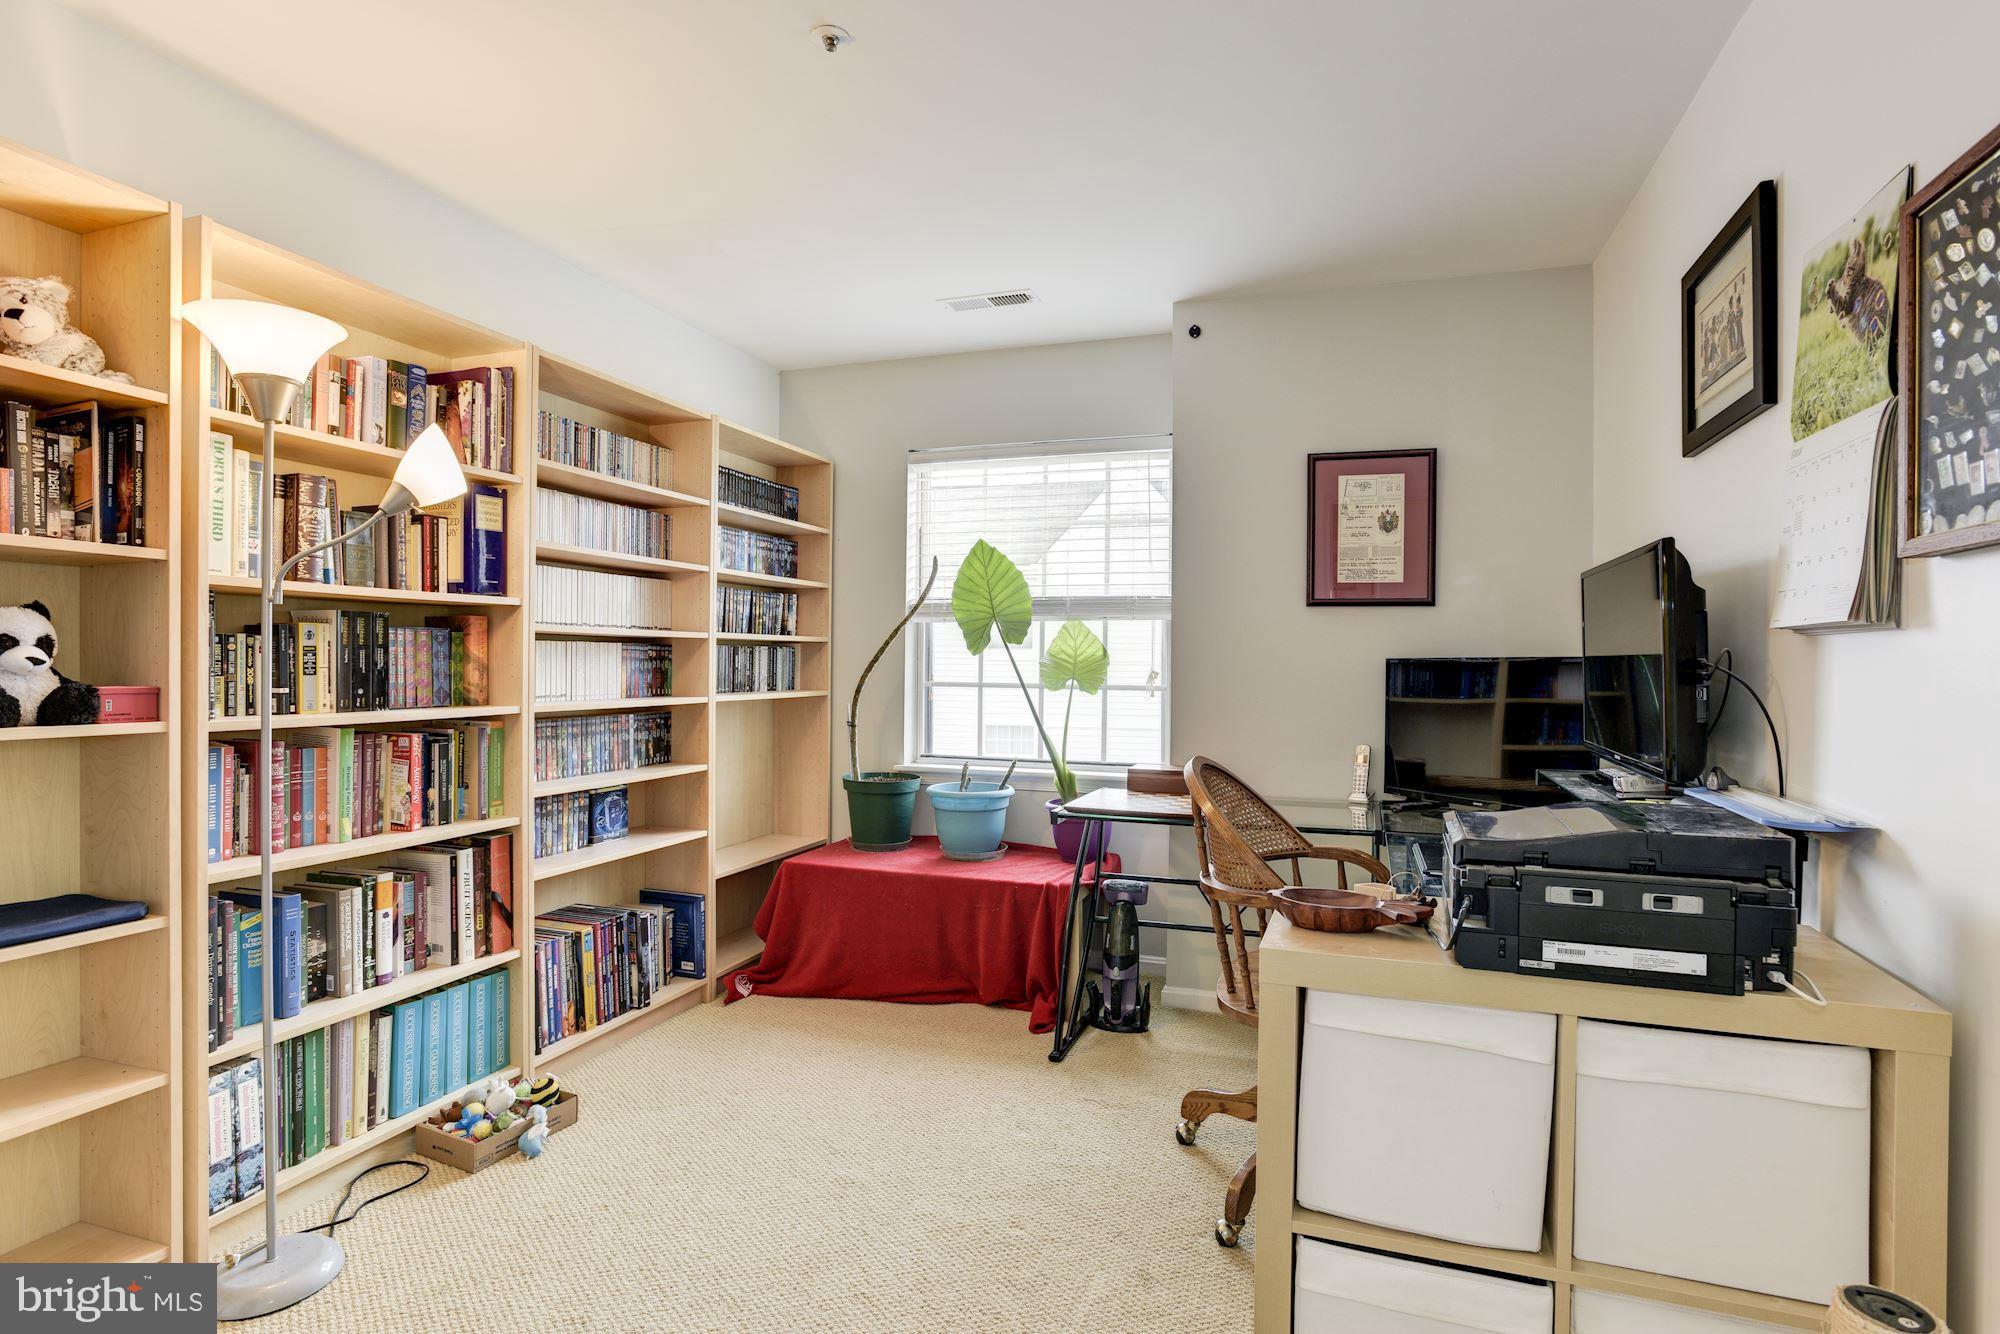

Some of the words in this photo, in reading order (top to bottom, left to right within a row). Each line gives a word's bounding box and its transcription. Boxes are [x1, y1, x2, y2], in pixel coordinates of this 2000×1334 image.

[32, 438, 45, 473] SHADA
[213, 440, 226, 494] HORTUS
[33, 477, 41, 504] DOUGLAS
[33, 504, 41, 526] ADAMS
[213, 496, 226, 542] THIRD
[412, 766, 420, 804] Astrology
[463, 872, 472, 899] FRUIT
[464, 902, 472, 941] SCIENCE
[431, 1048, 440, 1095] GARDENING
[454, 1038, 462, 1083] GARDENING
[404, 1059, 414, 1107] GARDENING
